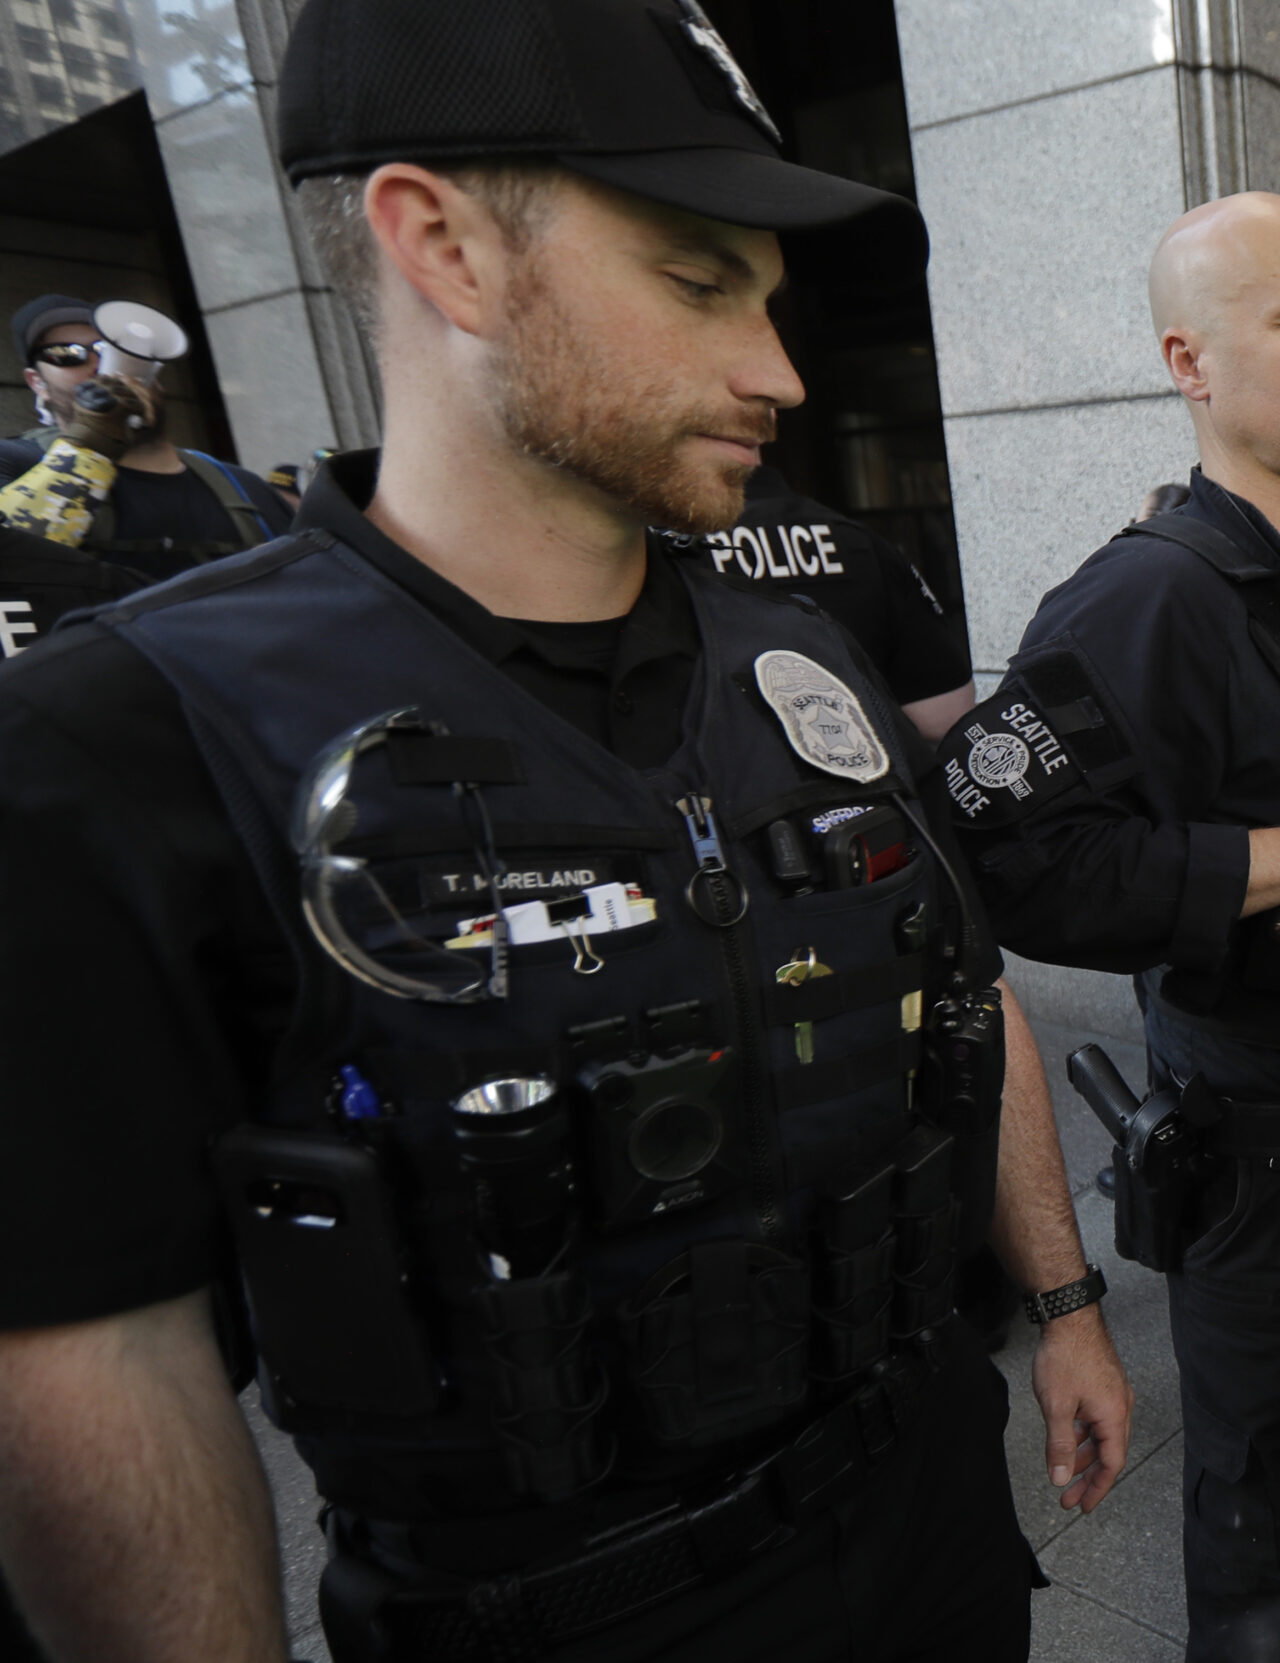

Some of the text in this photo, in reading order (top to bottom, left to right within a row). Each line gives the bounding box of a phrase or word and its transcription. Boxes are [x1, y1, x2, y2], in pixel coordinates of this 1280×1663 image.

[706, 524, 844, 579] POLICE
[793, 695, 838, 710] SEATTLE
[982, 735, 1016, 747] SERVICE
[1001, 703, 1068, 775] SEATTLE
[827, 753, 868, 767] POLICE
[945, 758, 991, 818] POLICE
